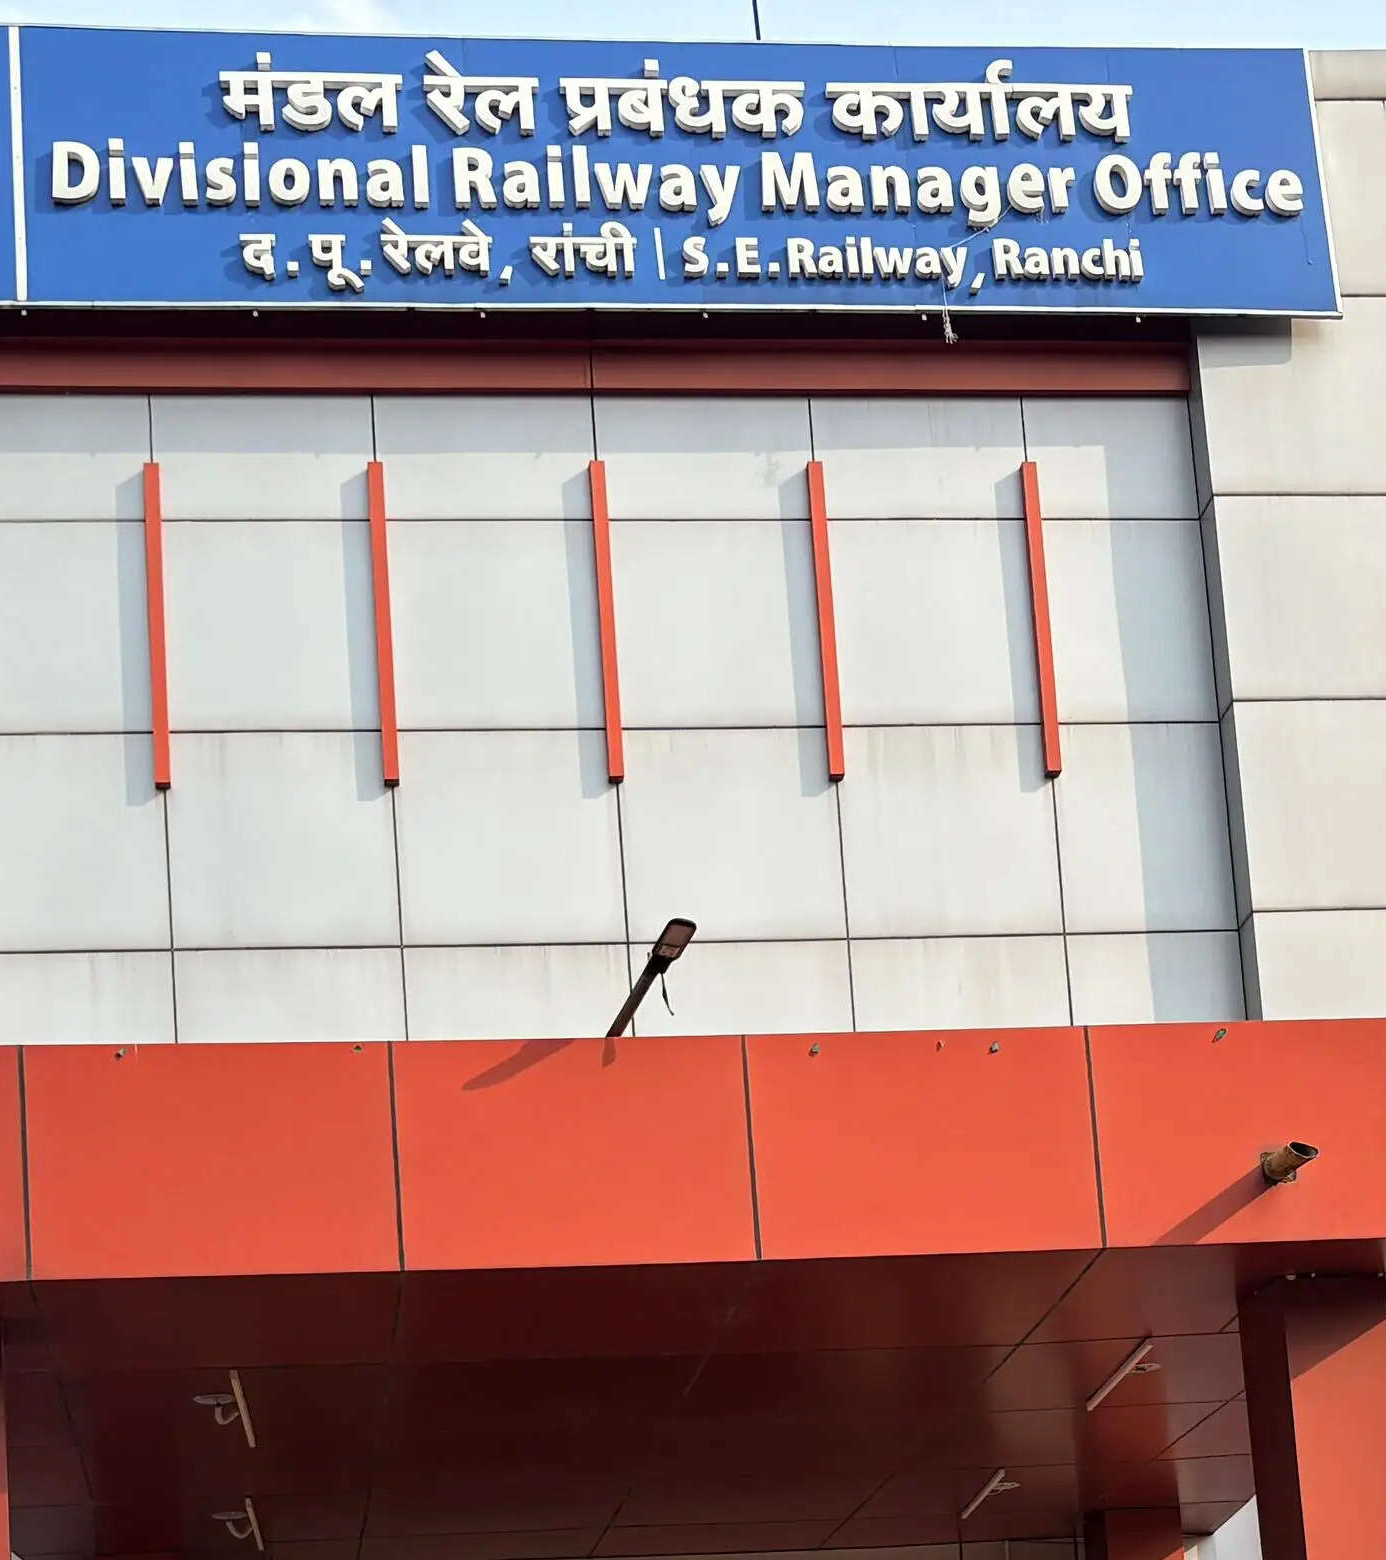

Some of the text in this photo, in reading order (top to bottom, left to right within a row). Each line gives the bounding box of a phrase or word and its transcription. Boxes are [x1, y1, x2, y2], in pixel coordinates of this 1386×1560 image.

[219, 50, 1133, 144] मंडल रेल प्रबंधक कार्यालय
[52, 138, 1303, 230] Divisional Railway Manager Office
[529, 221, 636, 279] रांची
[992, 237, 1145, 283] Ranchi
